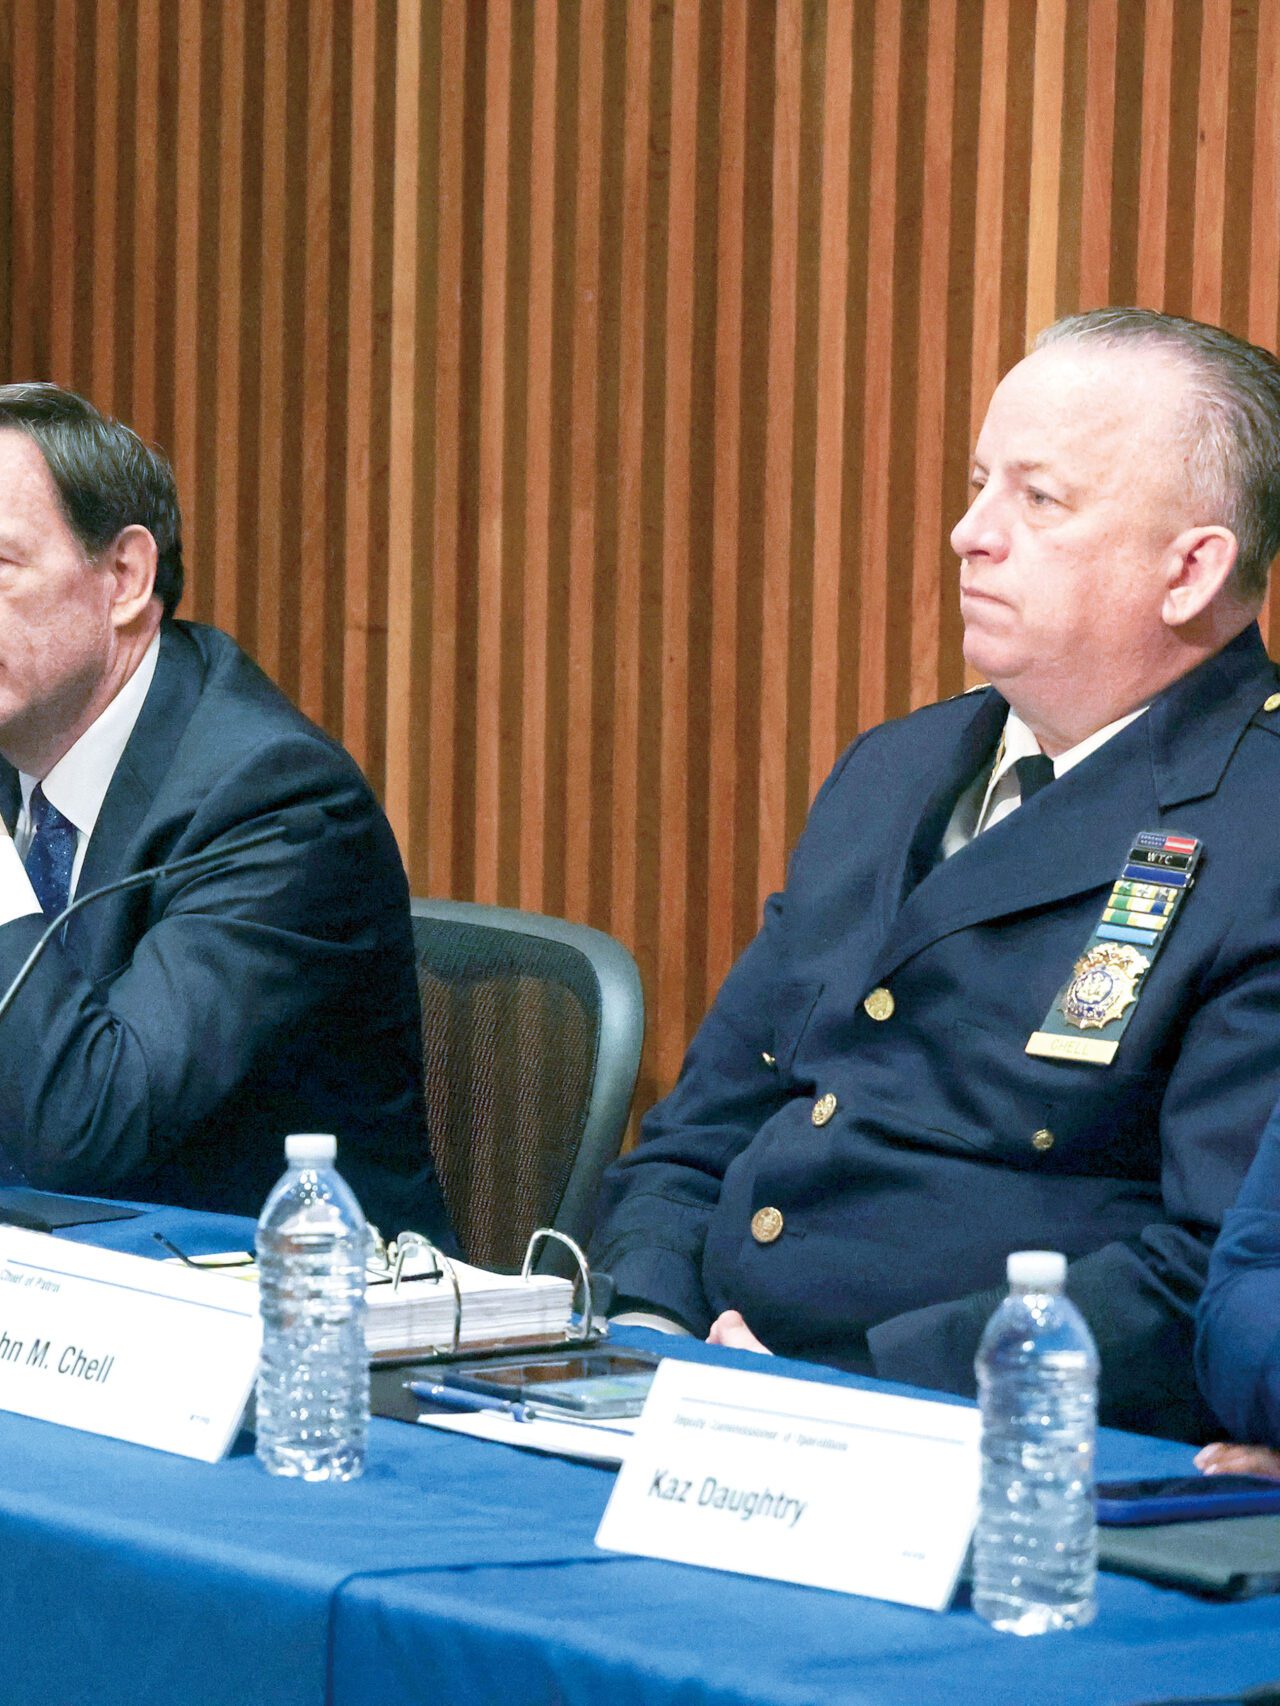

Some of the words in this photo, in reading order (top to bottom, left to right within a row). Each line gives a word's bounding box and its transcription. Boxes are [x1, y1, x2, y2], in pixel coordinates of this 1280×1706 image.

[1147, 852, 1173, 865] WTC
[25, 1339, 51, 1370] M.
[58, 1346, 115, 1384] Chell
[647, 1468, 692, 1504] Kaz
[697, 1475, 808, 1529] Daughtry
